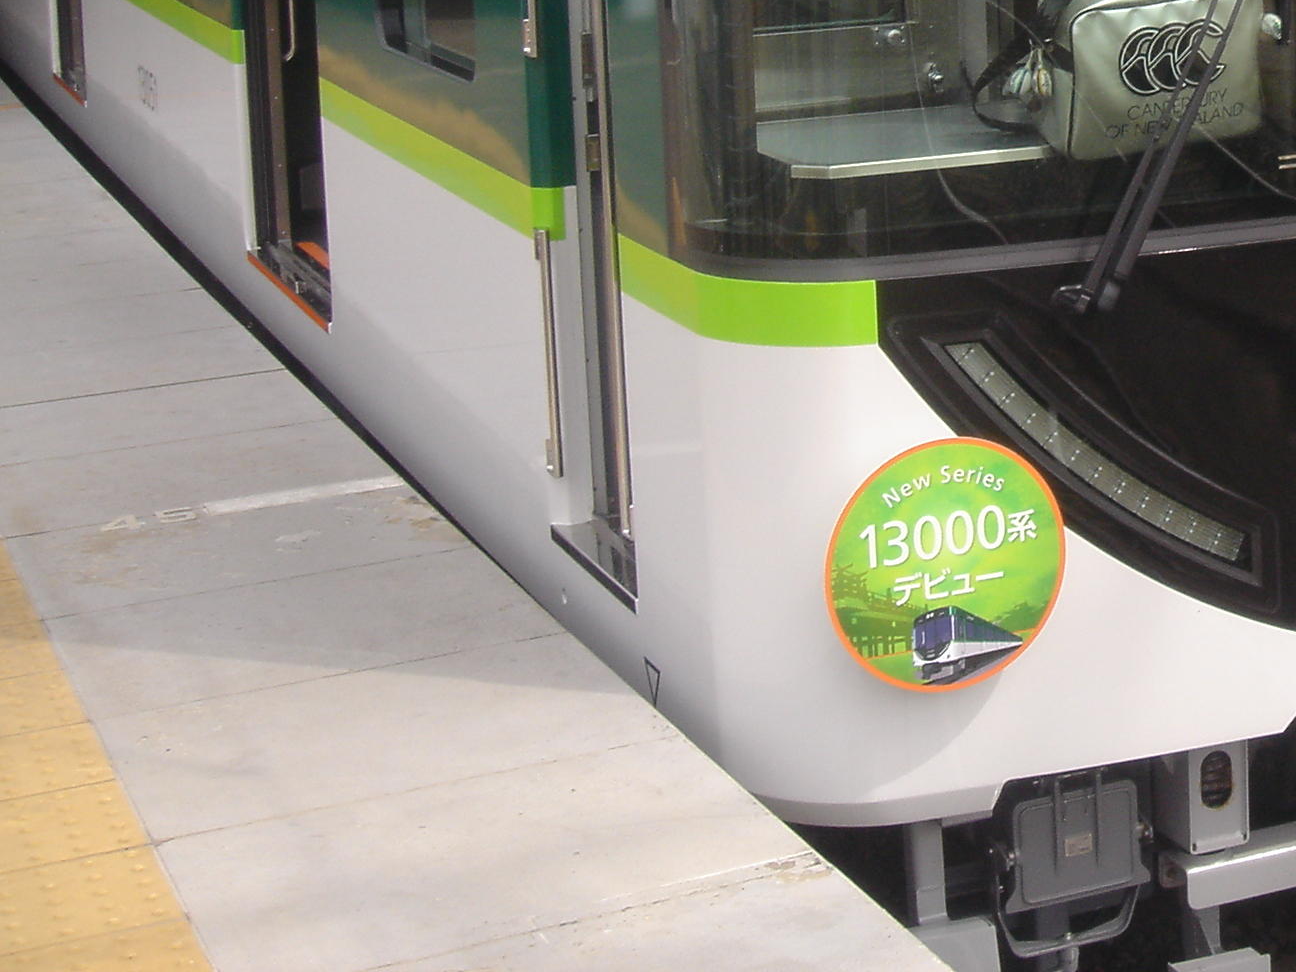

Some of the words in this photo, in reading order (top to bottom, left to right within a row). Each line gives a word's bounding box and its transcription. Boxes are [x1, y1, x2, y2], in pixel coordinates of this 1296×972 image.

[1105, 123, 1129, 139] OF
[881, 473, 932, 508] New
[940, 466, 1005, 492] Series
[858, 505, 1038, 570] 13000系
[893, 569, 1005, 607] デビュー
